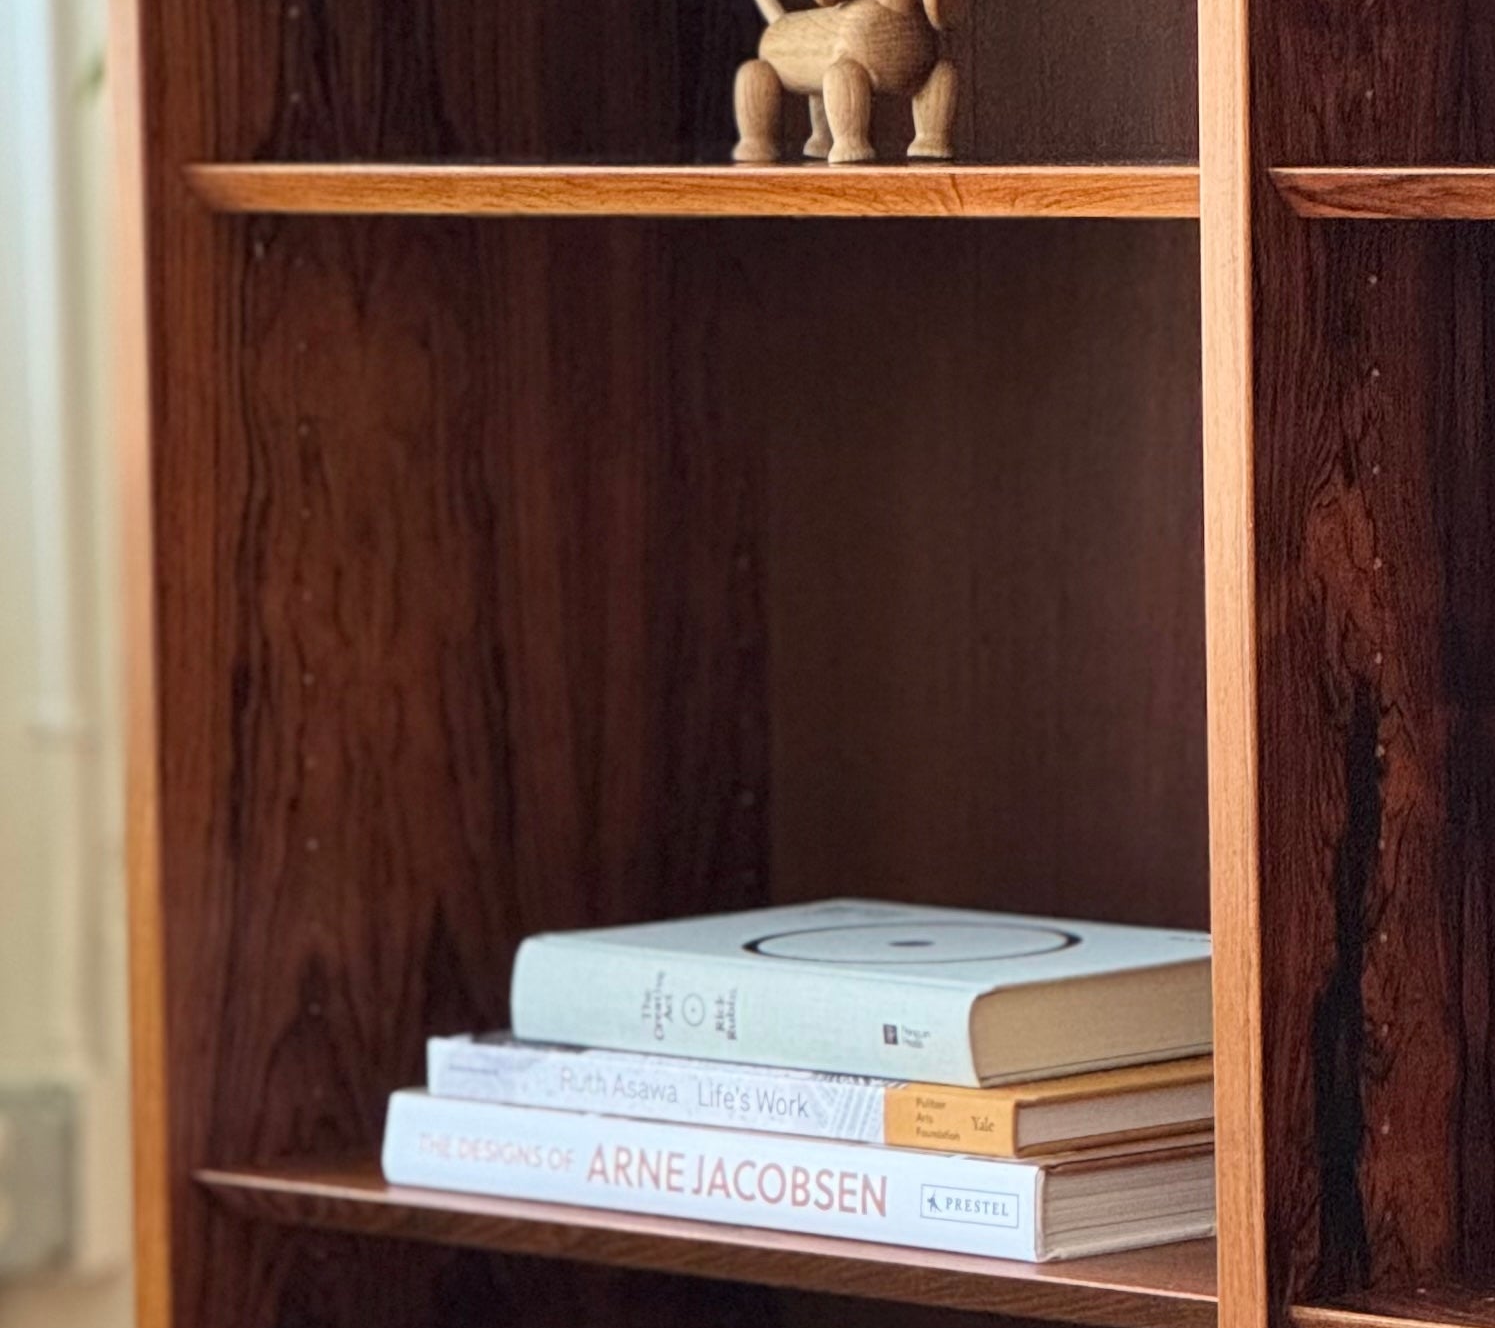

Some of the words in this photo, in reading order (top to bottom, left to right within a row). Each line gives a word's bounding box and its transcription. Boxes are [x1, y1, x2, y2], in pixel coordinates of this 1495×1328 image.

[559, 1067, 608, 1096] Ruth
[611, 1073, 678, 1104] Asawa
[698, 1081, 752, 1112] Life's
[756, 1088, 809, 1119] Work
[971, 1115, 995, 1132] Yale
[419, 1132, 452, 1159] THE
[458, 1137, 543, 1168] DESIGNS
[548, 1147, 576, 1170] OF
[587, 1144, 686, 1193] ARNE
[692, 1153, 888, 1218] JACOBSEN
[945, 1196, 1009, 1217] PRESTEL
